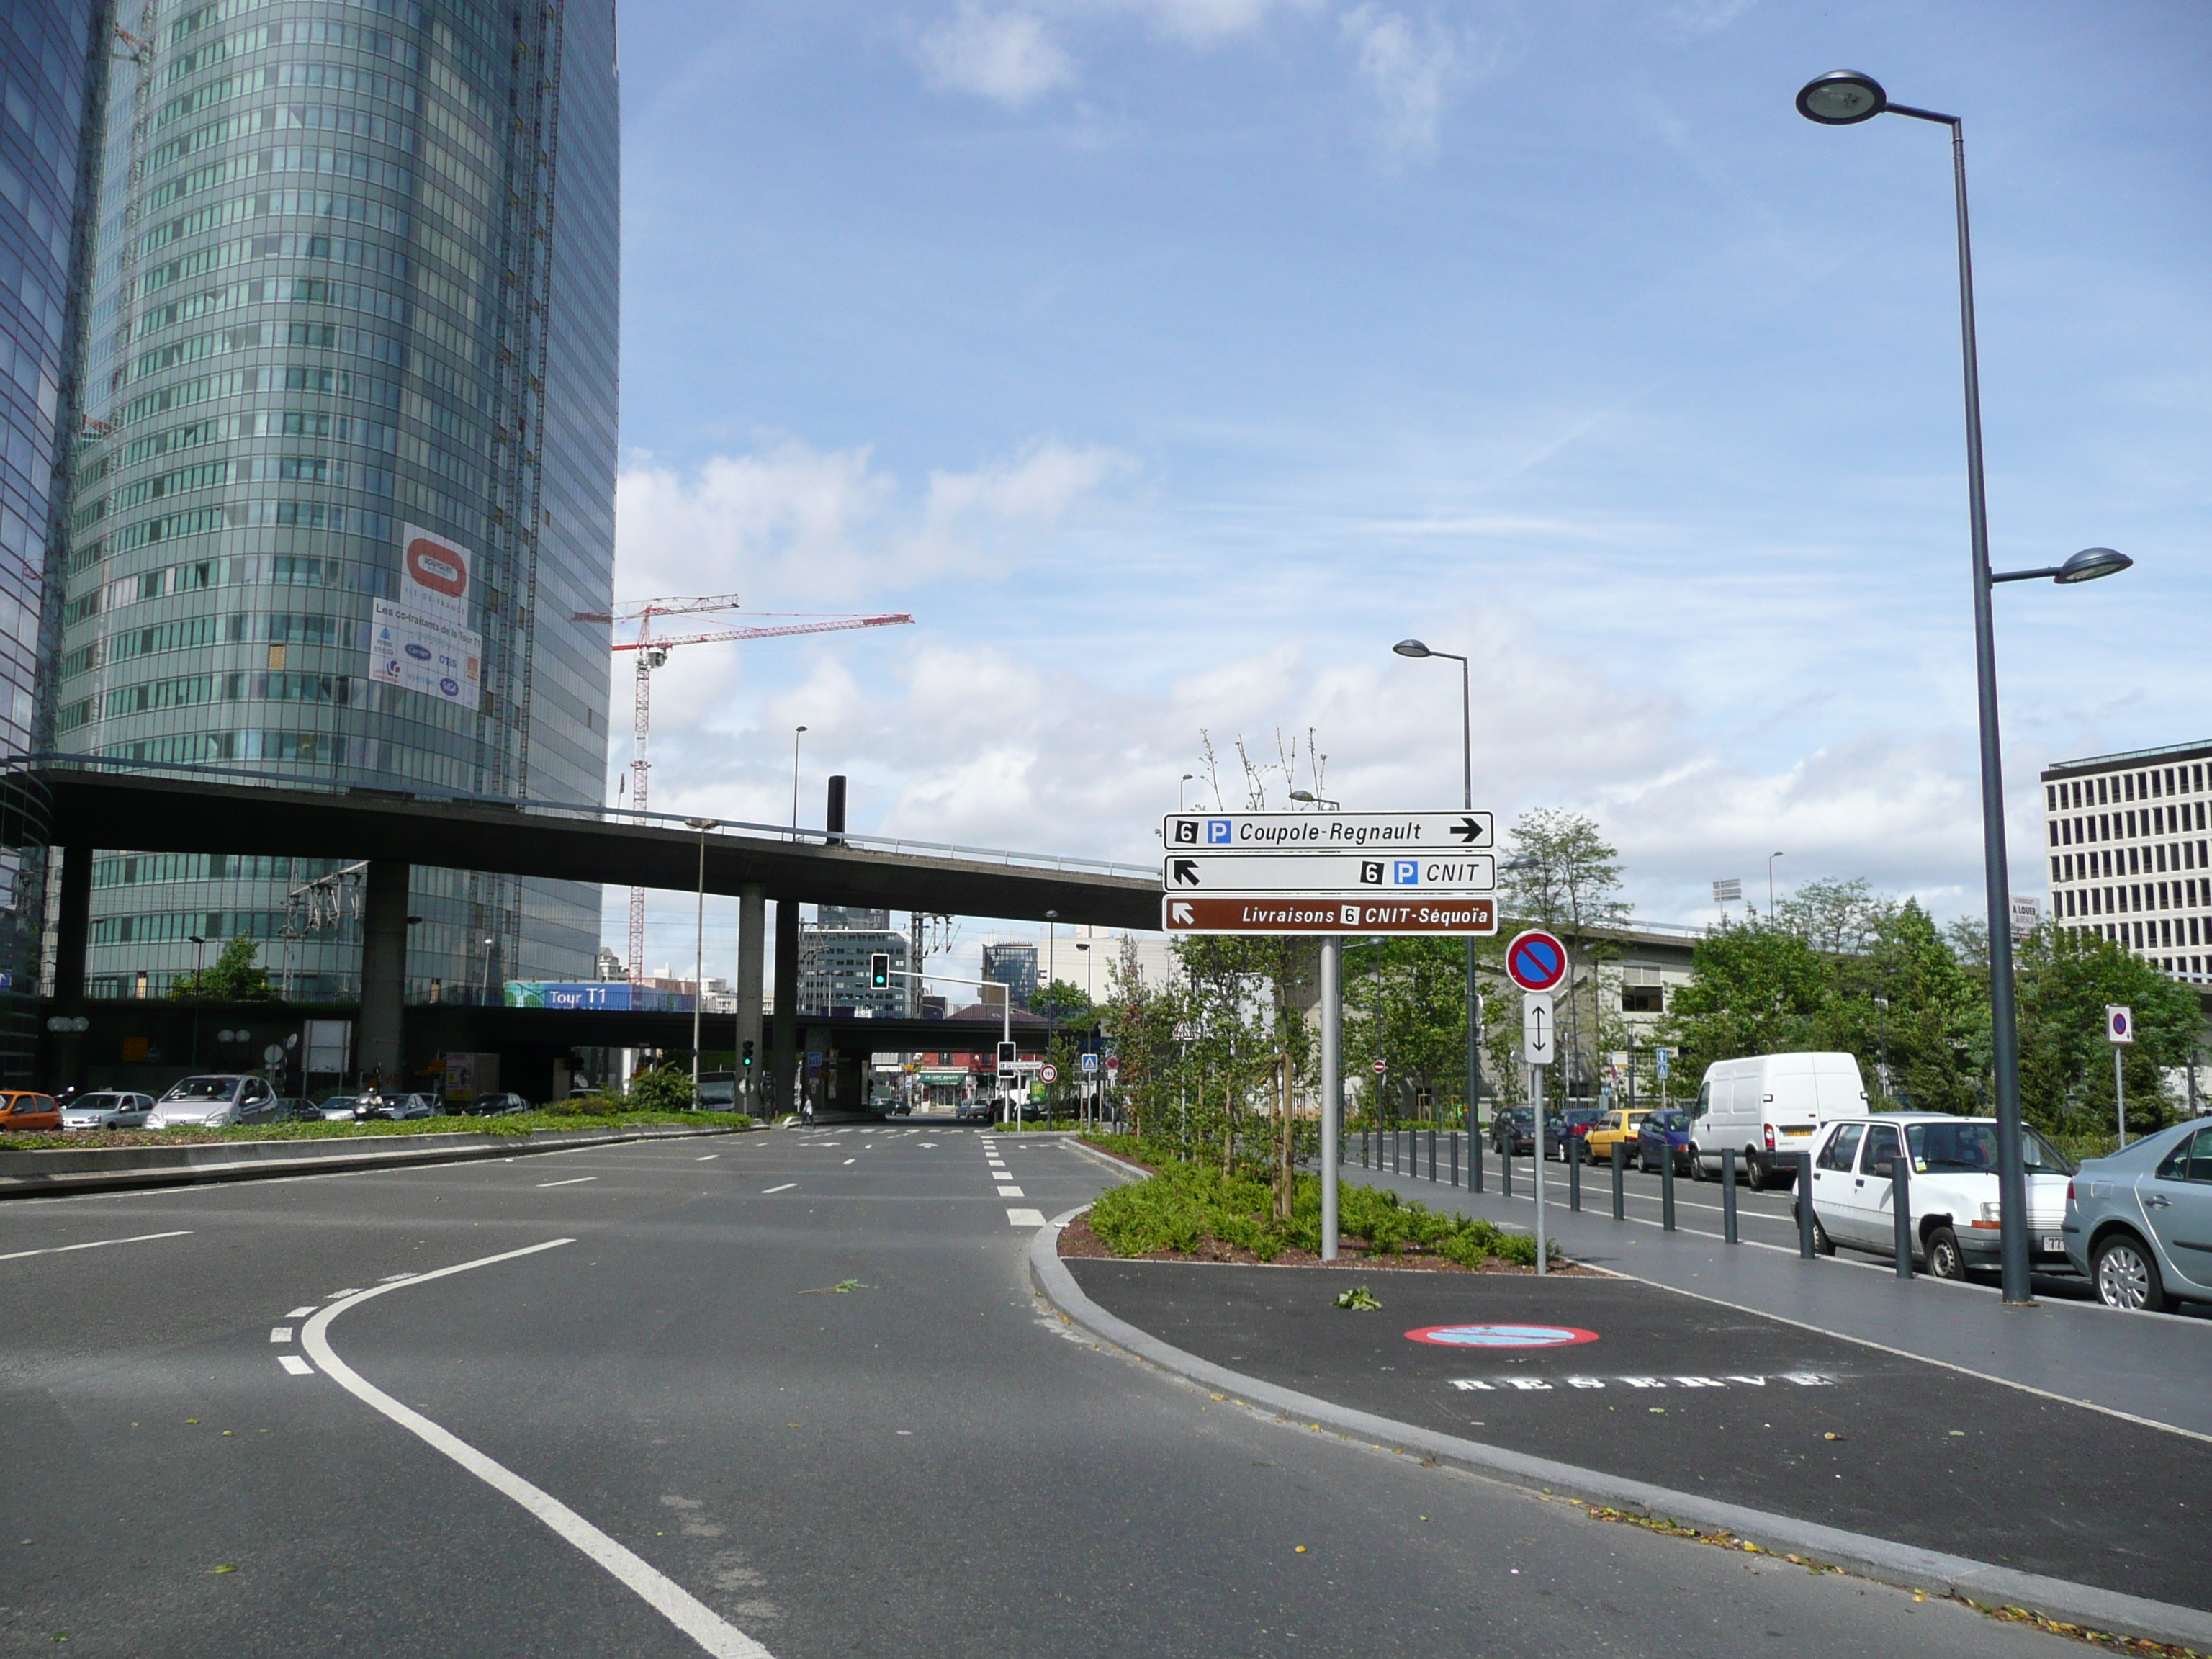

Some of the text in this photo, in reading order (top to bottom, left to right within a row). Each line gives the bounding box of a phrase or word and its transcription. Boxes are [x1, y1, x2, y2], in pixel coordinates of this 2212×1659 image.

[376, 603, 393, 616] Les
[395, 611, 439, 631] co-traitants
[441, 625, 450, 635] de
[452, 628, 458, 638] la
[459, 631, 473, 644] Tour
[474, 637, 481, 647] T1
[439, 655, 457, 668] OTIS
[1181, 822, 1421, 845] 6 P Coupole-Regnault
[1366, 864, 1480, 882] 6 P CNIT
[1242, 907, 1488, 927] Livraisons 6 CNIT-Séquoïa
[2018, 905, 2036, 915] LOUER
[550, 988, 606, 1004] Tour T1
